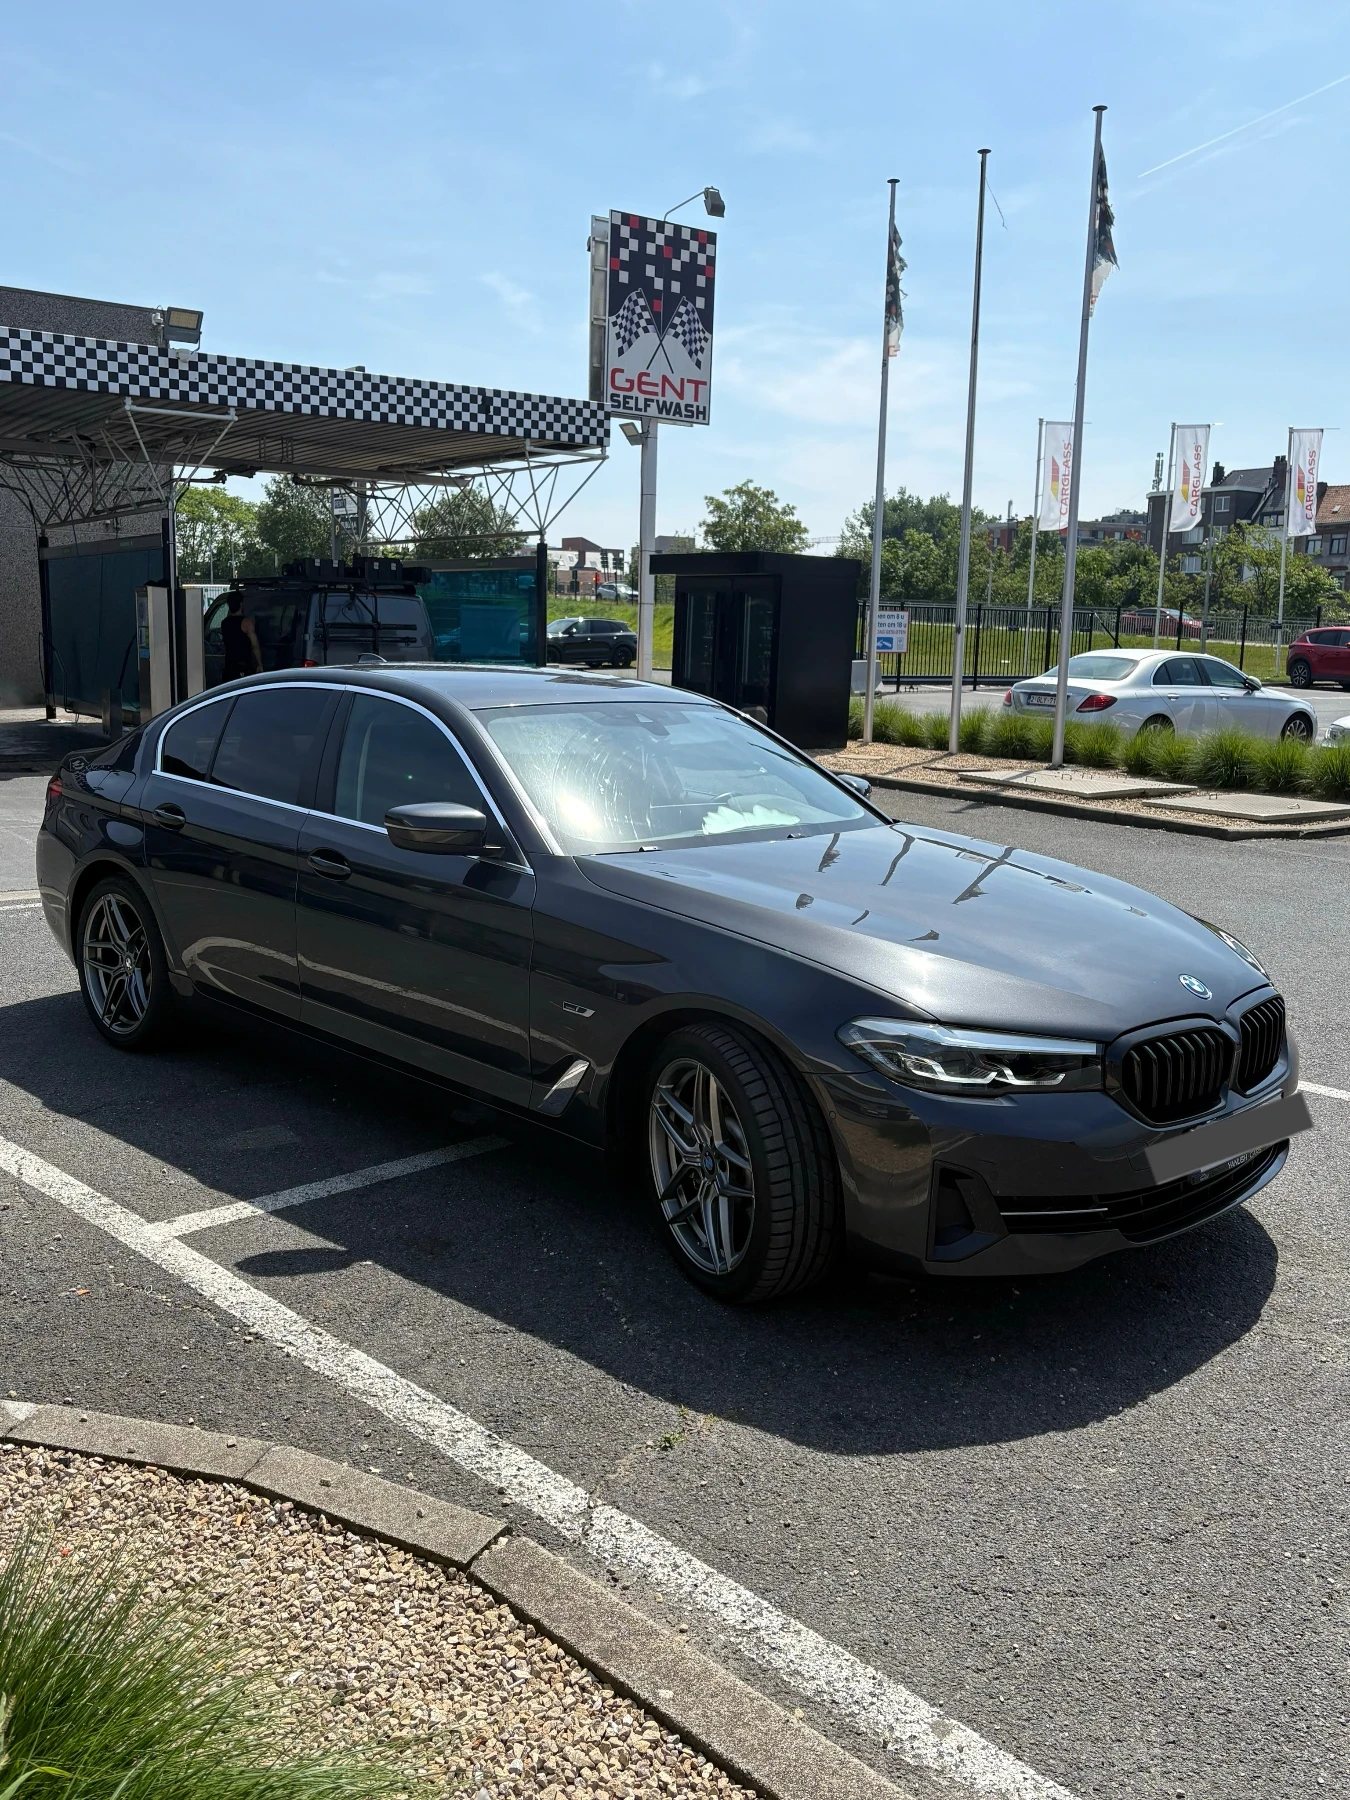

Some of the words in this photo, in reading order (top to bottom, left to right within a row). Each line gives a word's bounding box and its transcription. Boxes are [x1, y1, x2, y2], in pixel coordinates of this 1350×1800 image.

[610, 367, 708, 402] GENT
[610, 393, 707, 421] SELFWASH
[1060, 442, 1072, 516] CARGLASS
[1190, 444, 1202, 517] CARGLASS
[1305, 450, 1317, 521] CARGLASS
